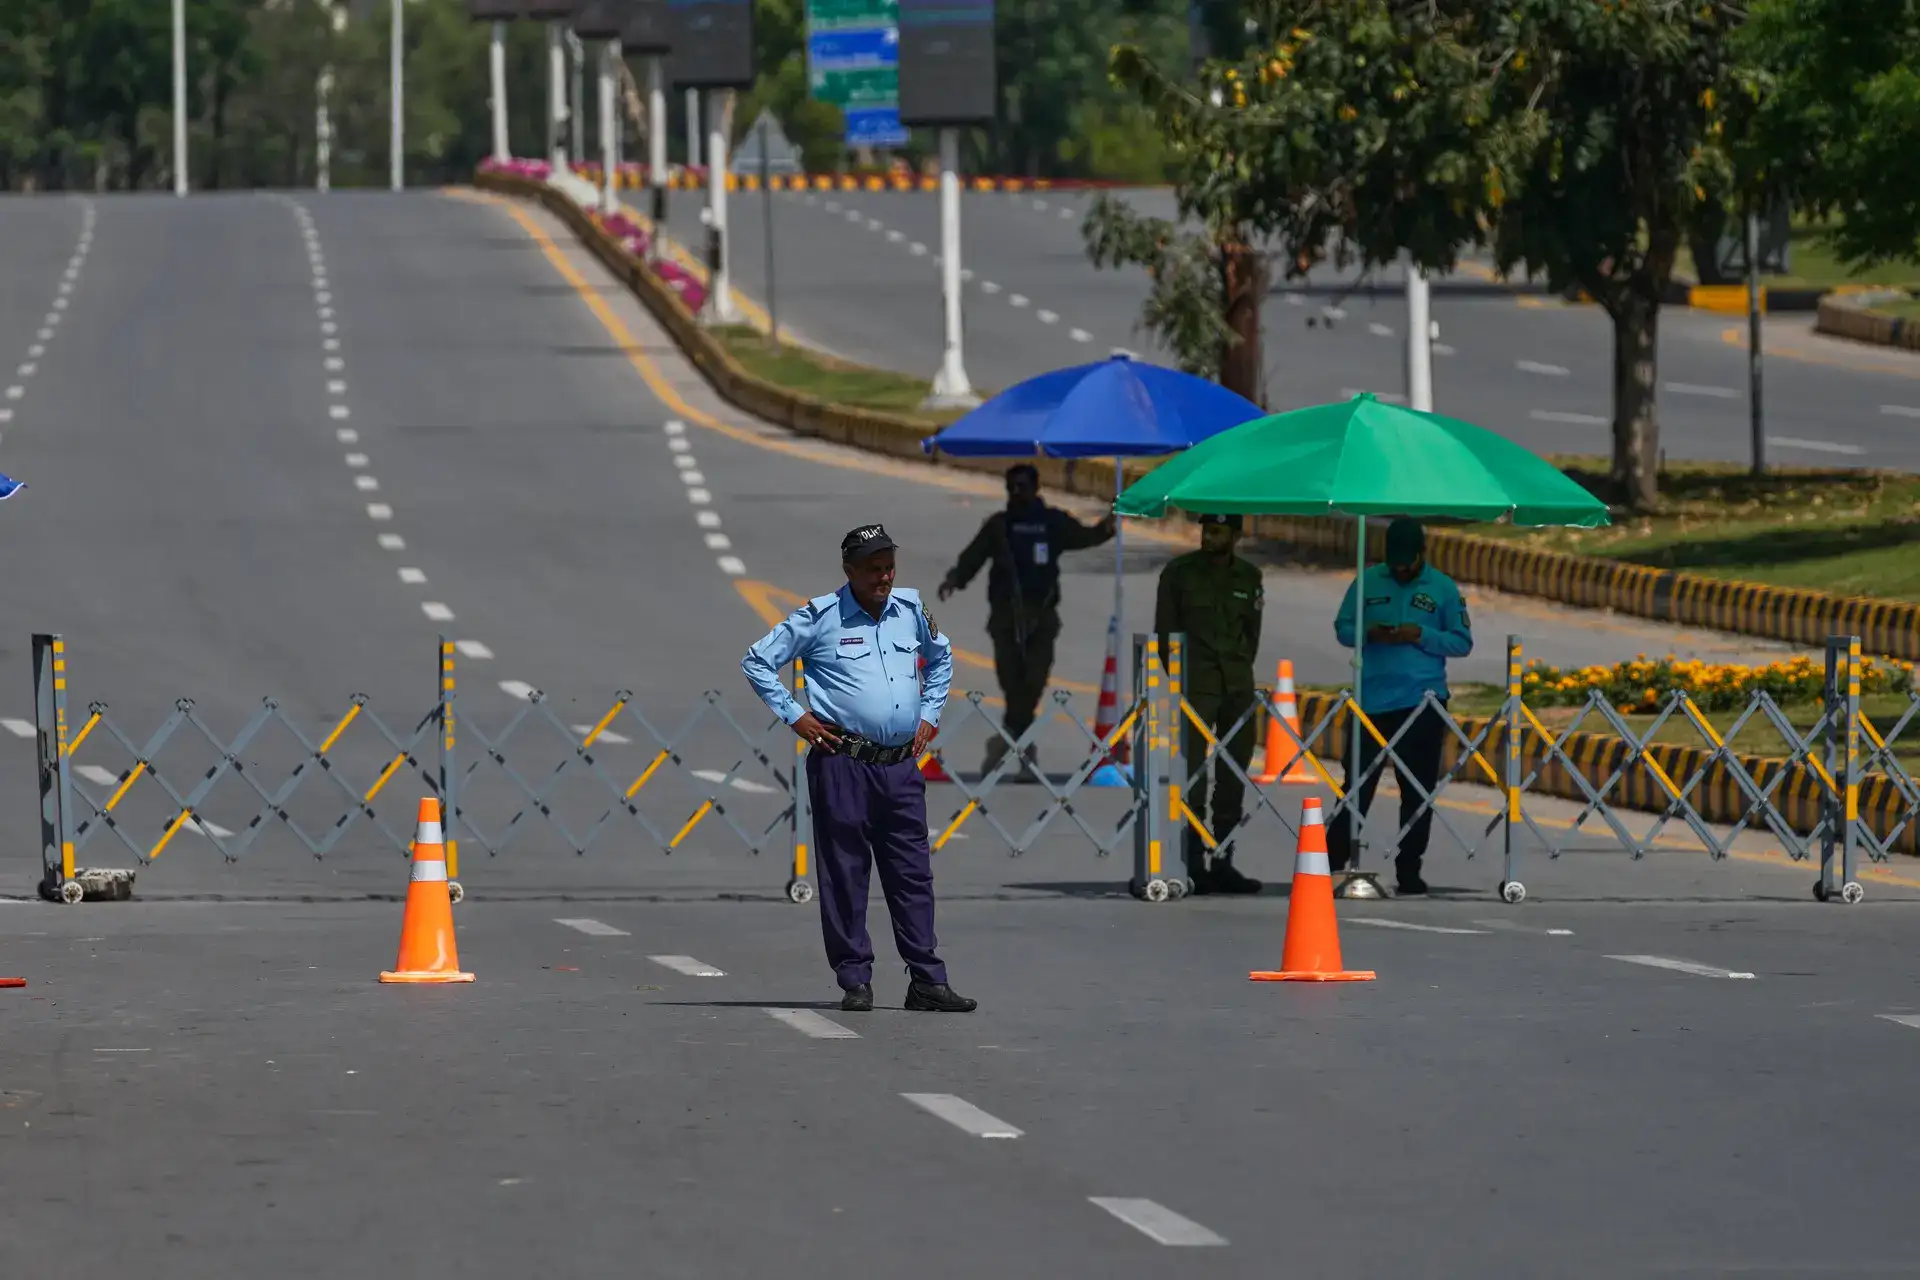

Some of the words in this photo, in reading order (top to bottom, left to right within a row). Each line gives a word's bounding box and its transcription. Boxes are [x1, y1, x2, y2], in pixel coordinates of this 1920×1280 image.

[57, 708, 68, 757] ITP
[444, 703, 455, 750] ITP
[1149, 703, 1160, 750] ITP
[1510, 712, 1521, 760] ITP
